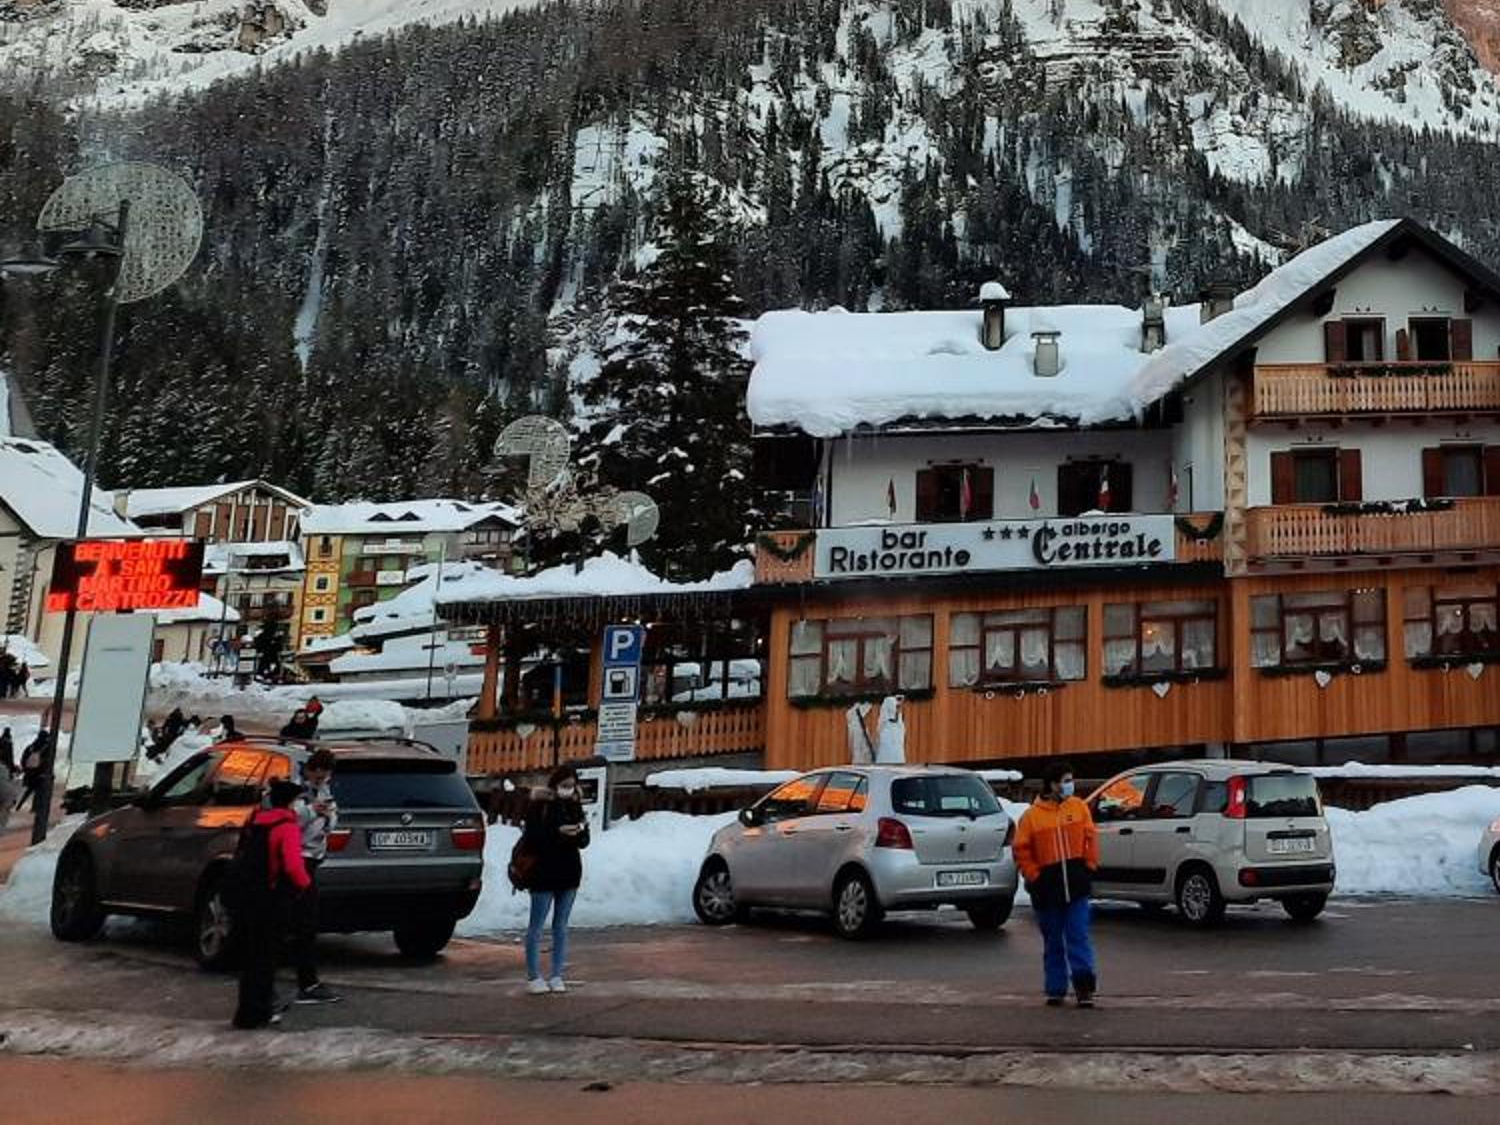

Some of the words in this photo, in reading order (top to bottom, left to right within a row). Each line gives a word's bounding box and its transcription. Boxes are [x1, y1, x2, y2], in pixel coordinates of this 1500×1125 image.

[881, 528, 927, 550] bar
[1061, 521, 1131, 538] albergo
[74, 540, 187, 561] BENVENUTI
[1032, 520, 1161, 565] Centrale
[95, 559, 110, 577] A
[120, 559, 162, 576] SAN
[829, 545, 971, 573] Ristorante
[78, 575, 171, 593] MARTINO
[76, 589, 198, 611] CASTROZZA
[611, 630, 635, 660] P
